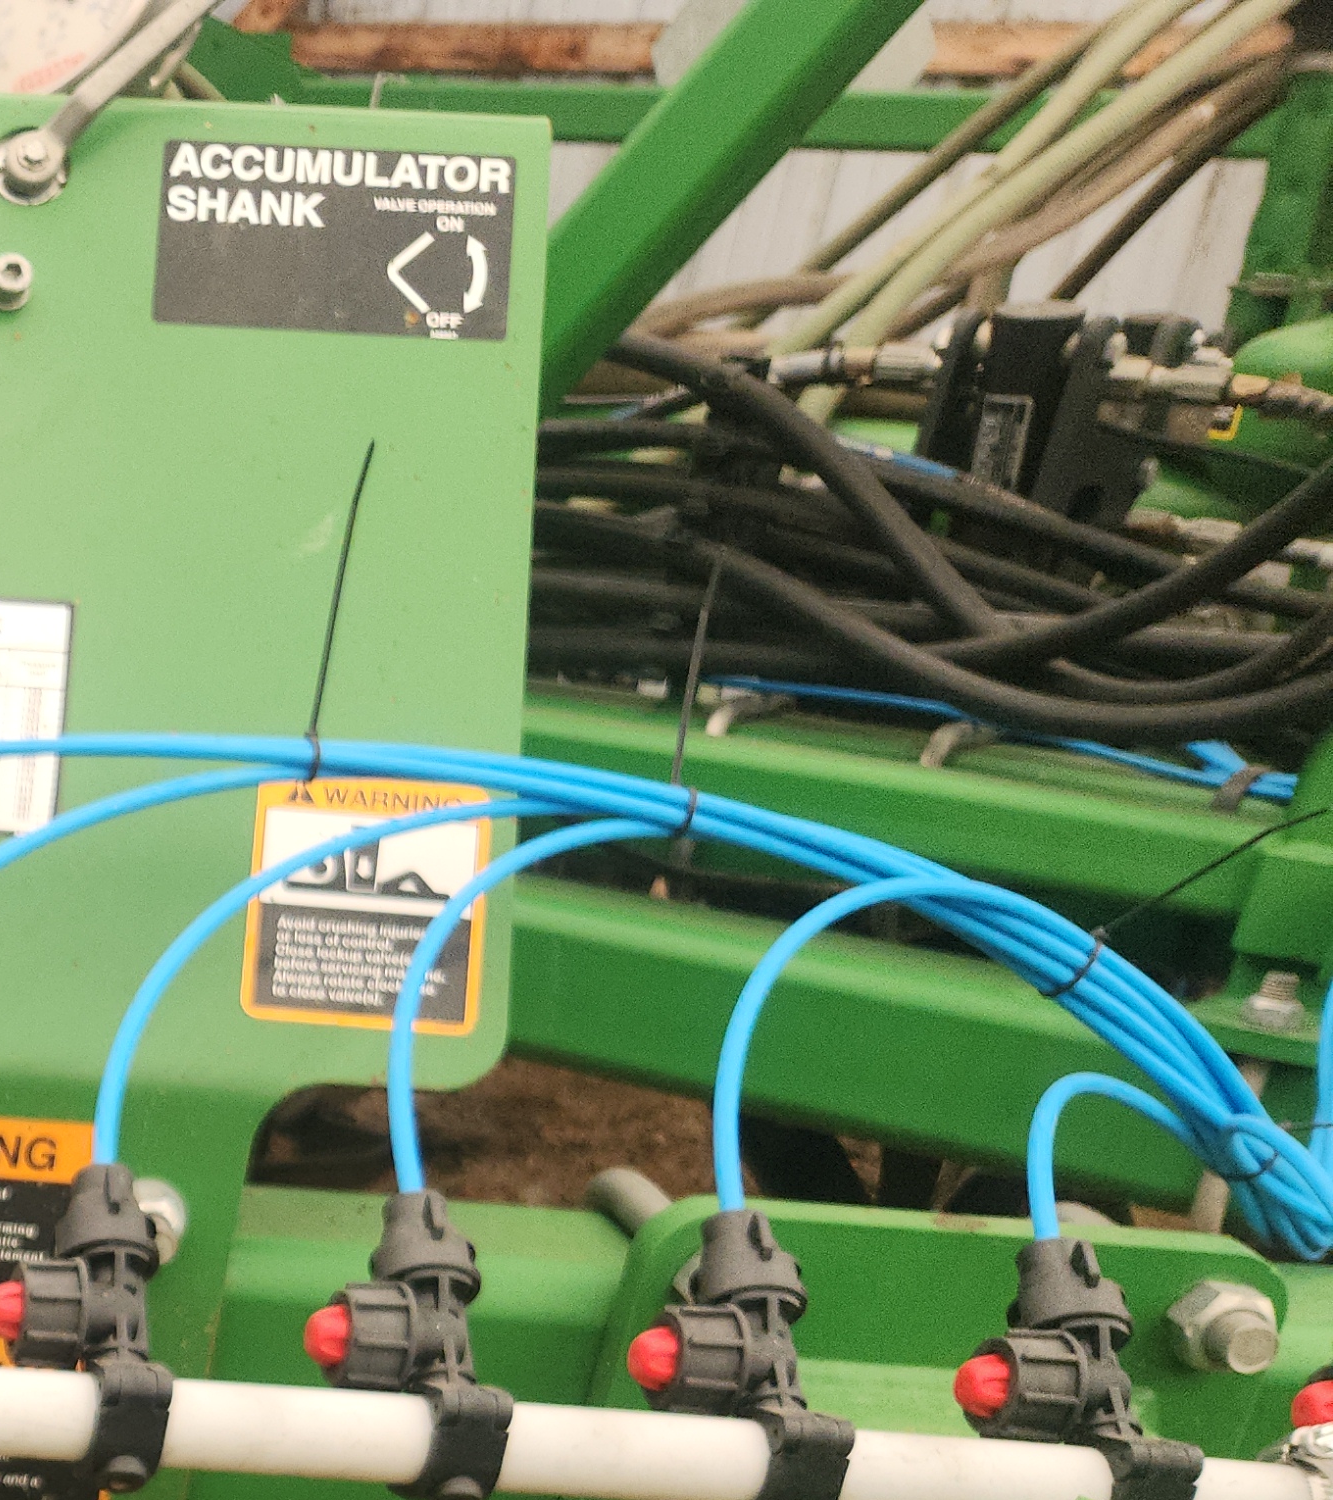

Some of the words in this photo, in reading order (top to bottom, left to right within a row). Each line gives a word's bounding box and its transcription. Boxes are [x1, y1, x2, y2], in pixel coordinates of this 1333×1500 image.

[168, 142, 511, 194] ACCUMULATOR
[166, 184, 326, 228] SHANK
[436, 216, 465, 233] ON
[426, 311, 464, 329] OFF
[324, 787, 463, 813] WARNIN
[277, 913, 316, 931] Avoid
[380, 923, 426, 941] injurie
[3, 1473, 29, 1487] and
[30, 1476, 42, 1489] a
